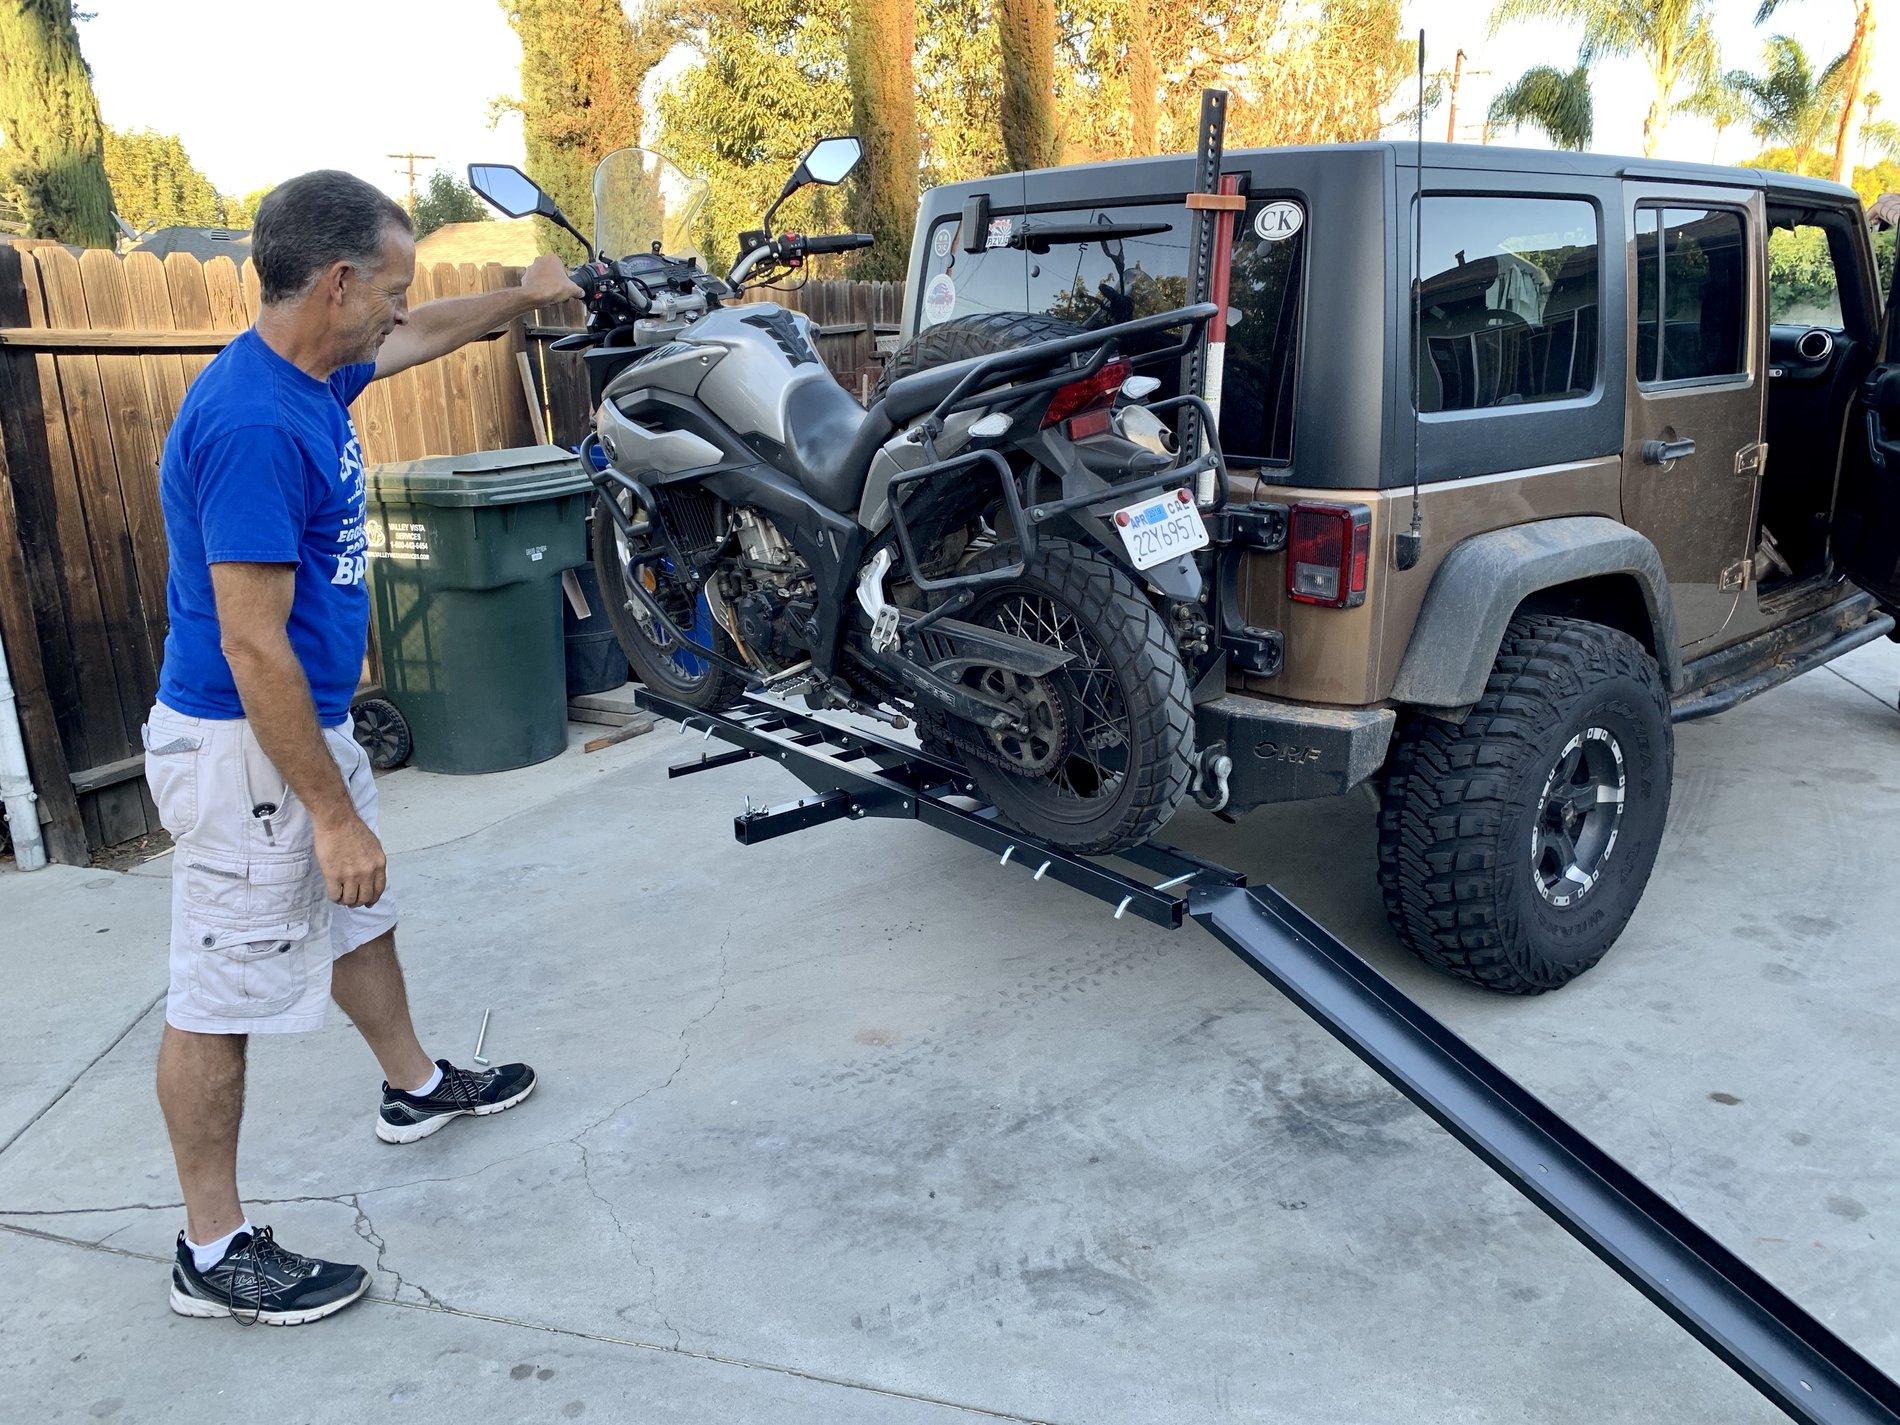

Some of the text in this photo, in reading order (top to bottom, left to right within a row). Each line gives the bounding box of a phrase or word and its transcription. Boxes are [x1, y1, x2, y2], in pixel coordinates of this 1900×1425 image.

[1261, 209, 1293, 231] CK
[388, 523, 426, 532] VALLEY VISTA
[1130, 514, 1149, 530] APR
[395, 532, 421, 541] SERVICES
[1133, 514, 1197, 557] 22Y6957
